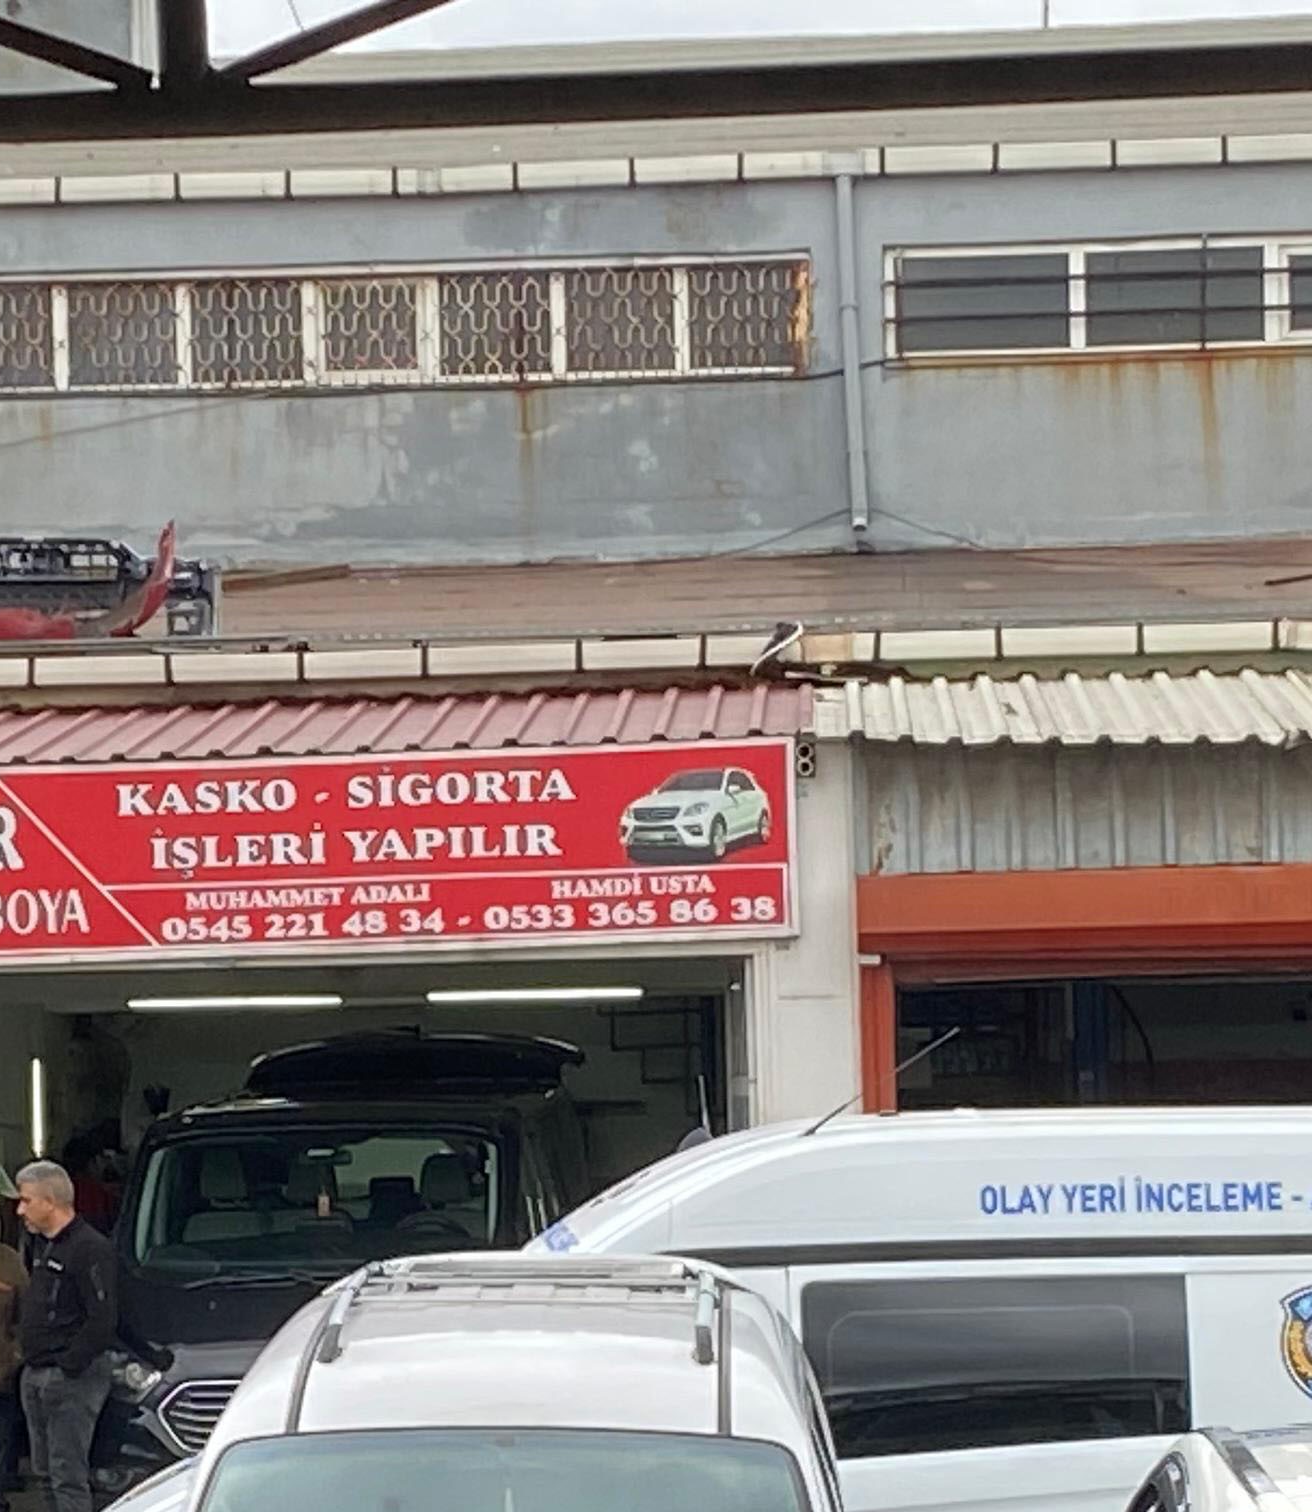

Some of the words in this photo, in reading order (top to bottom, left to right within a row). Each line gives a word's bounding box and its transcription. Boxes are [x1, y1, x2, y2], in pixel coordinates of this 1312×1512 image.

[116, 779, 296, 817] KASKO
[346, 765, 575, 810] SİGORTA
[151, 822, 326, 879] İŞLERİ
[344, 824, 562, 862] YAPILIR
[185, 889, 343, 911] MUHAMMET
[351, 883, 430, 905] ADALI
[551, 873, 643, 898] HAMDİ
[649, 875, 715, 895] USTA
[162, 917, 252, 942] 0545
[264, 913, 327, 939] 221
[341, 911, 388, 938] 48
[399, 908, 445, 935] 34
[484, 904, 575, 931] 0533
[588, 901, 665, 928] 365
[670, 899, 718, 925] 86
[730, 896, 776, 921] 38
[979, 1184, 1052, 1215] OLAY
[1061, 1175, 1126, 1214] YERİ
[1134, 1175, 1283, 1213] İNCELEME
